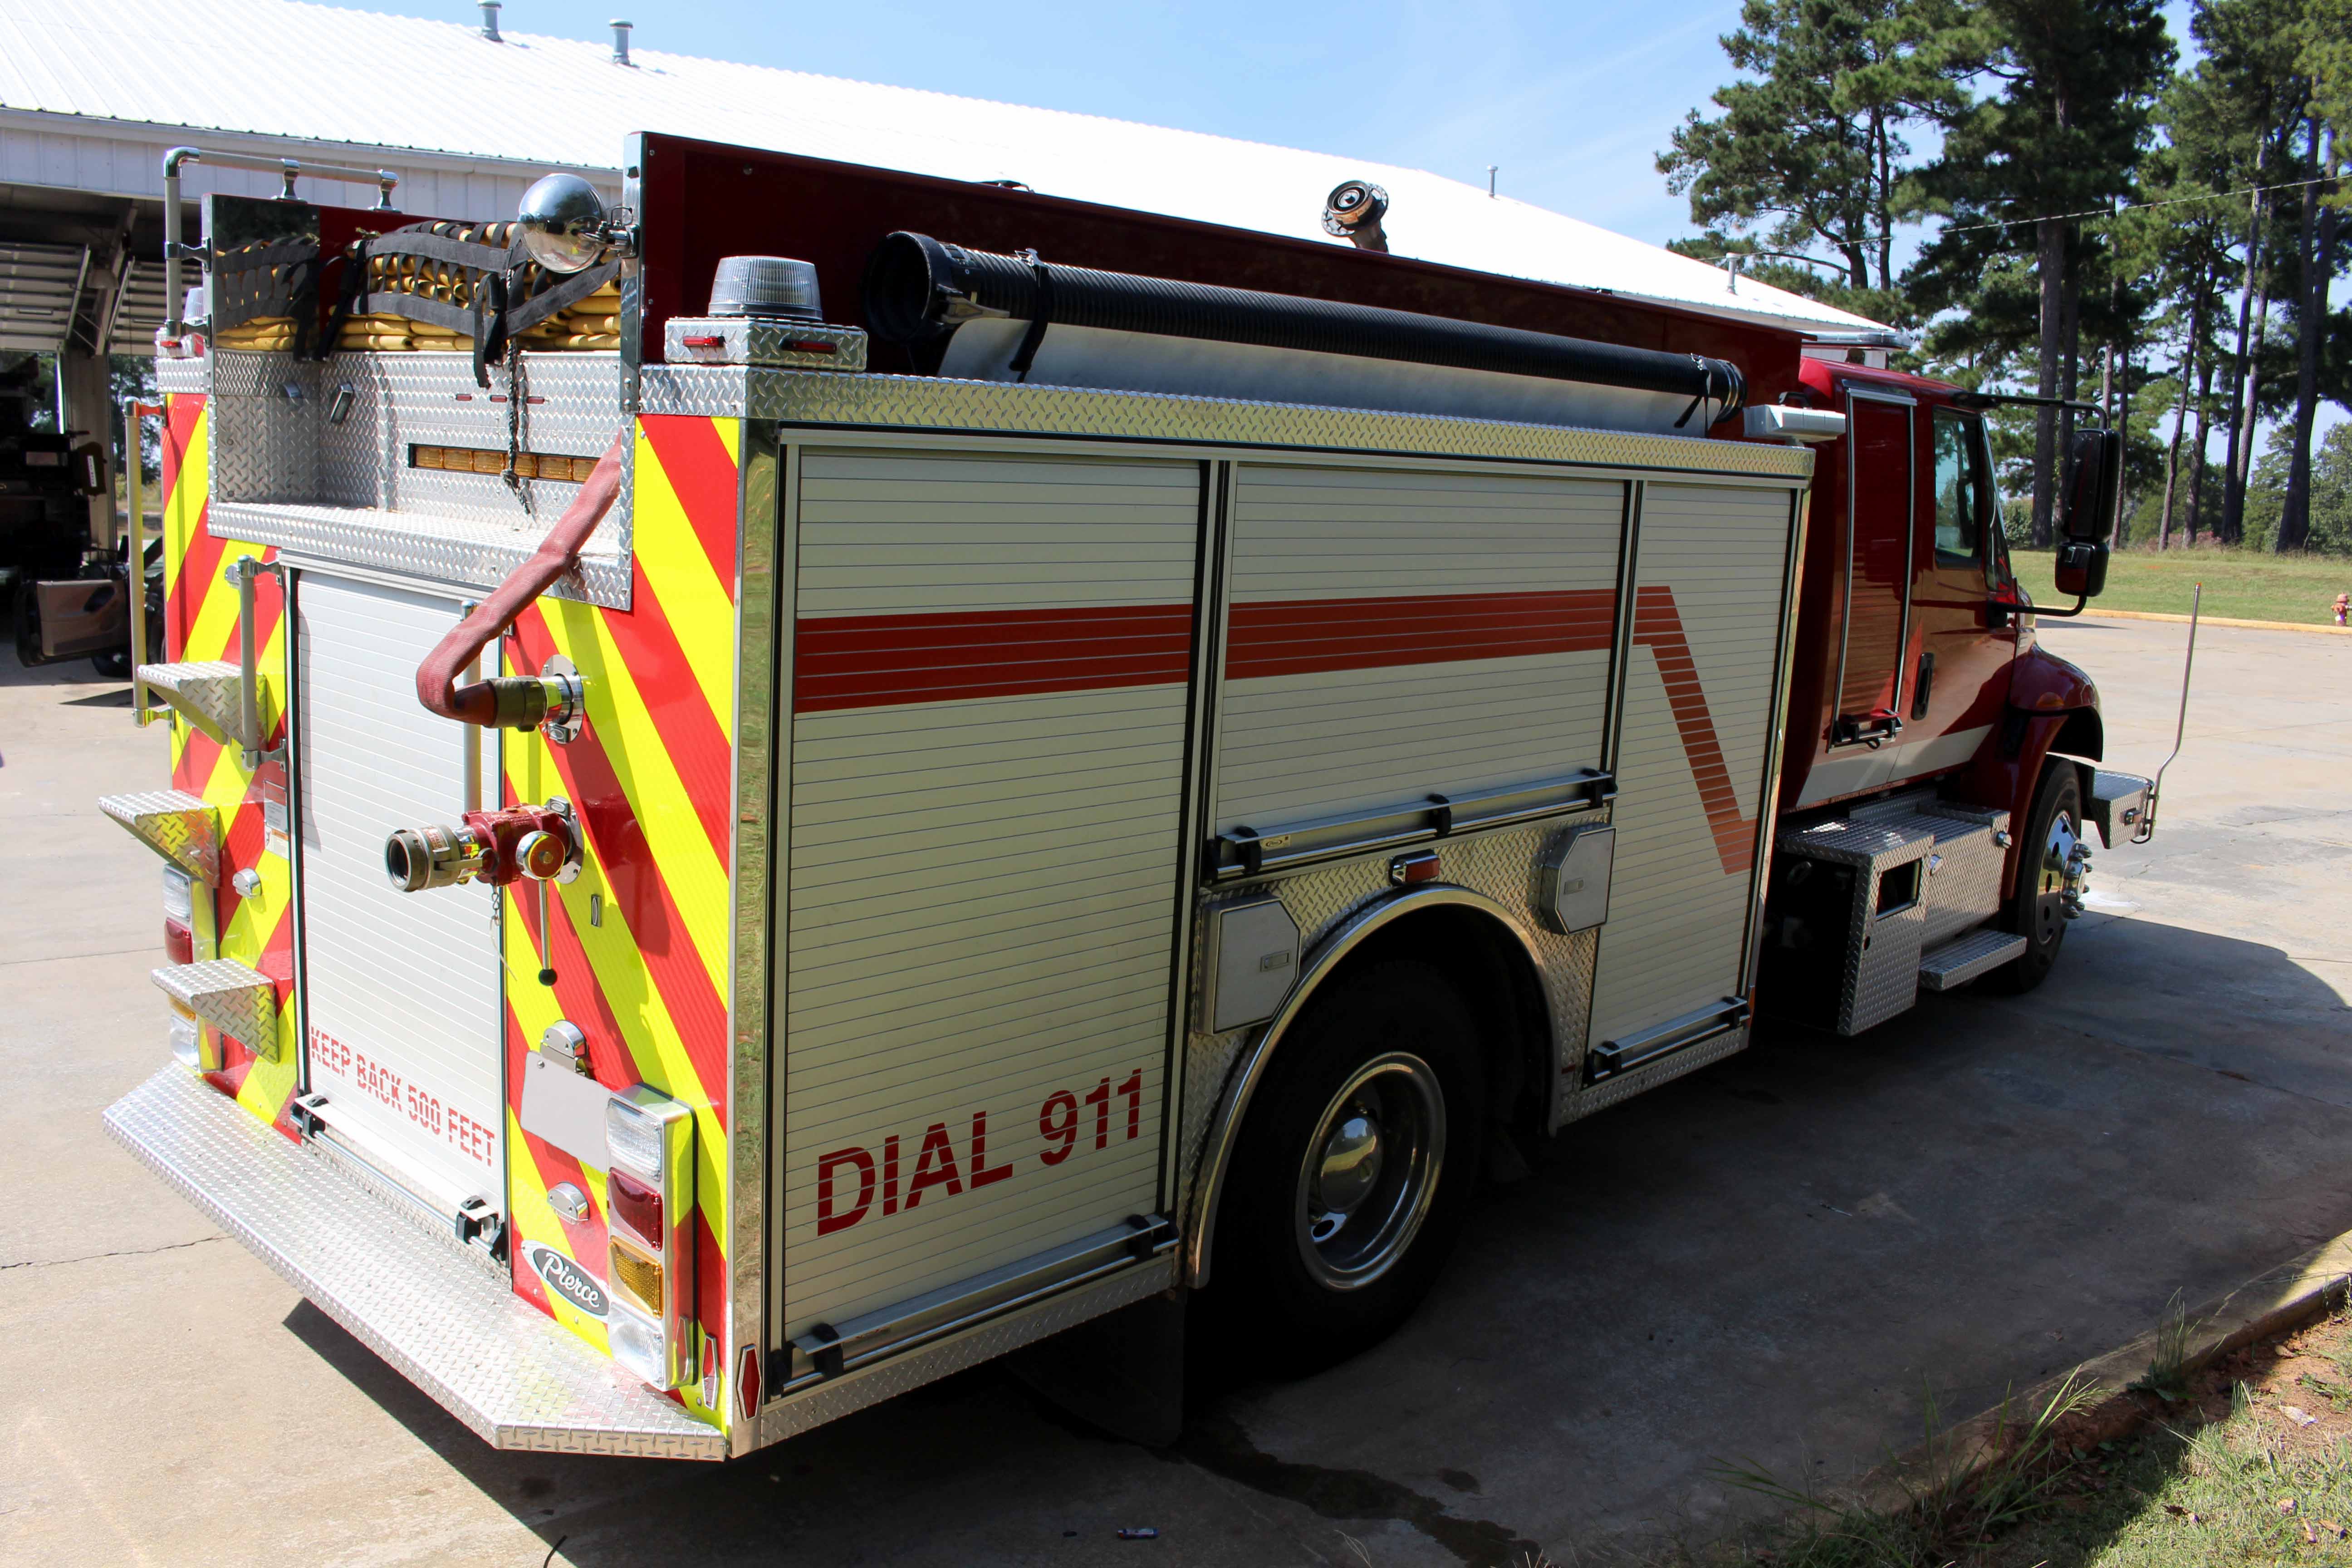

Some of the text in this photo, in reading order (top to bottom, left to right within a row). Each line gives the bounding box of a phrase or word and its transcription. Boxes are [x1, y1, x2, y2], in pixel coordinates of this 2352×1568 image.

[311, 1026, 495, 1167] KEEP BACK 500 FEET
[818, 1068, 1142, 1236] DIAL 911
[542, 1252, 601, 1308] Pierce
